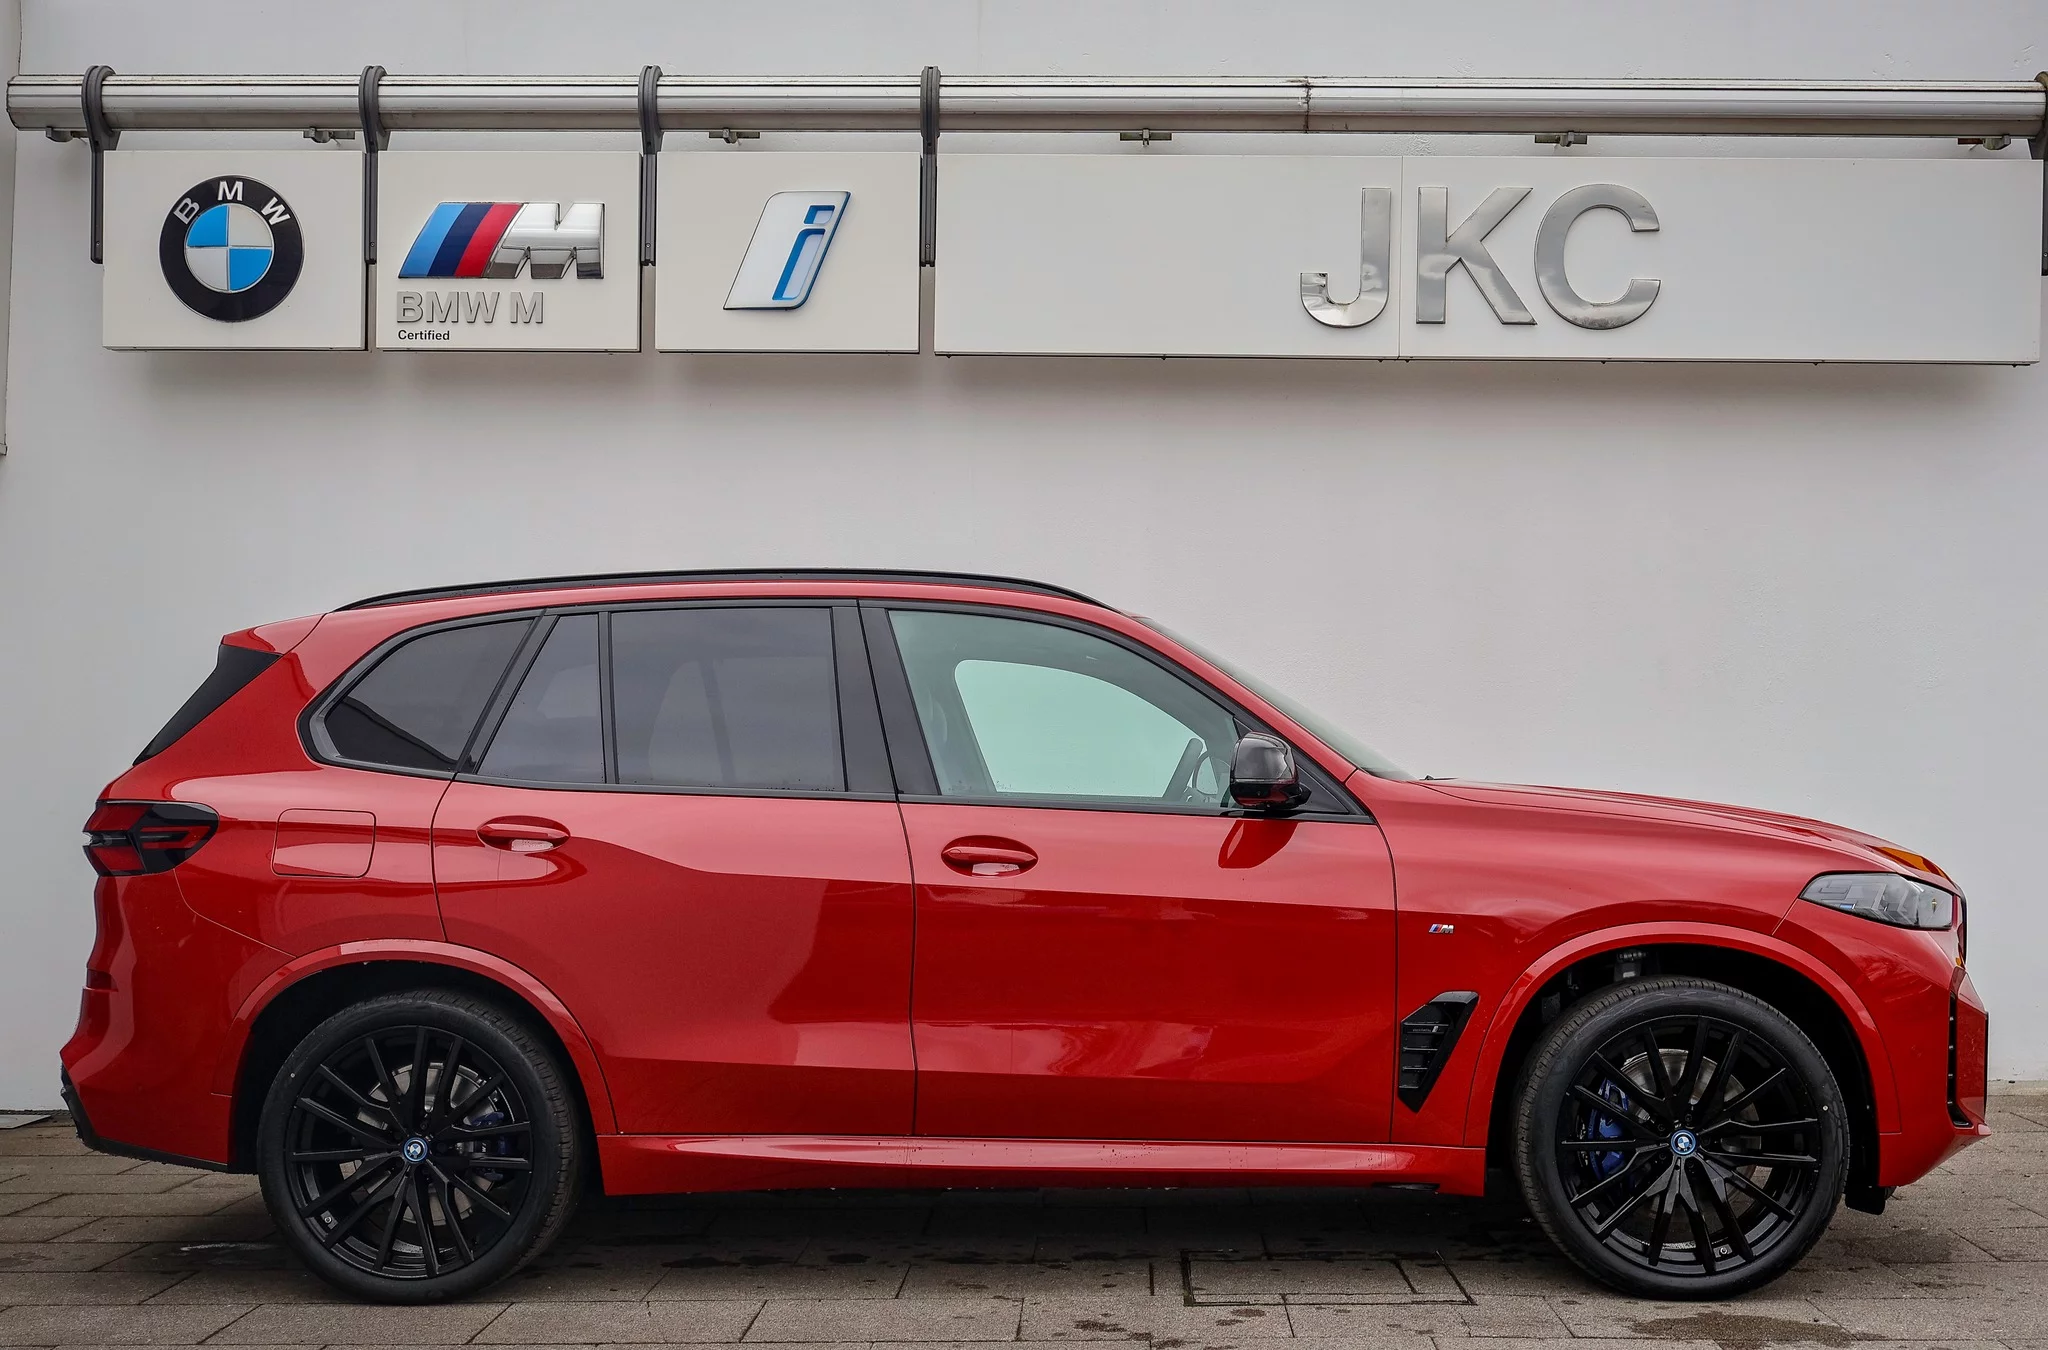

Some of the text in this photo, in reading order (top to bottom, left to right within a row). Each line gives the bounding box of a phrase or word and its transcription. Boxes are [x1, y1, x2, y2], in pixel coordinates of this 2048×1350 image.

[173, 180, 291, 225] BMW
[1300, 183, 1661, 330] JKC
[397, 291, 544, 324] BMW M
[398, 329, 450, 341] Certified
